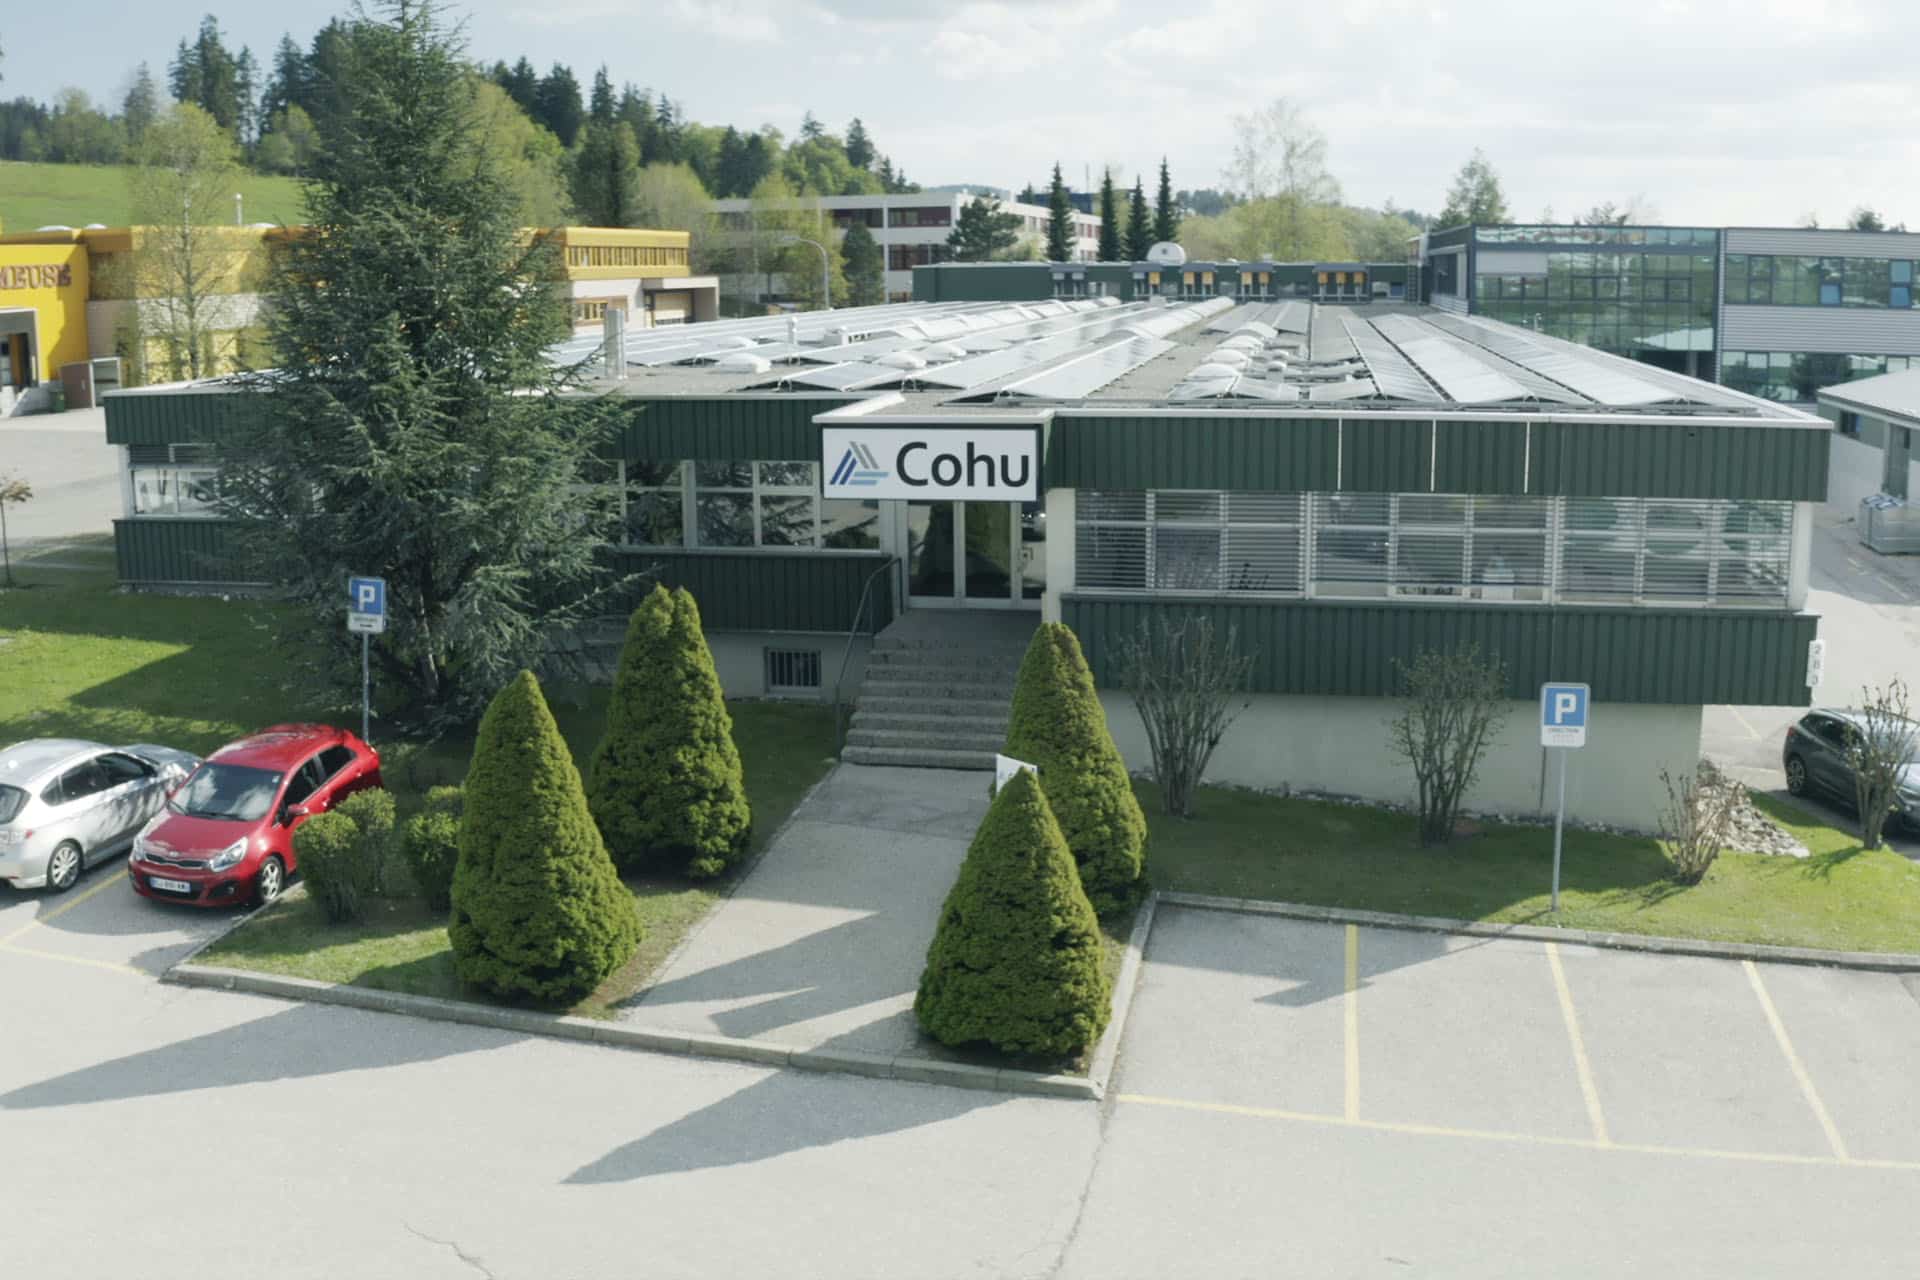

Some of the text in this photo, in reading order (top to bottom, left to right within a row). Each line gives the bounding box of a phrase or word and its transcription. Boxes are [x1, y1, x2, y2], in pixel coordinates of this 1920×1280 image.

[896, 441, 1029, 487] Cohu
[359, 585, 375, 611] P
[1555, 693, 1577, 723] P
